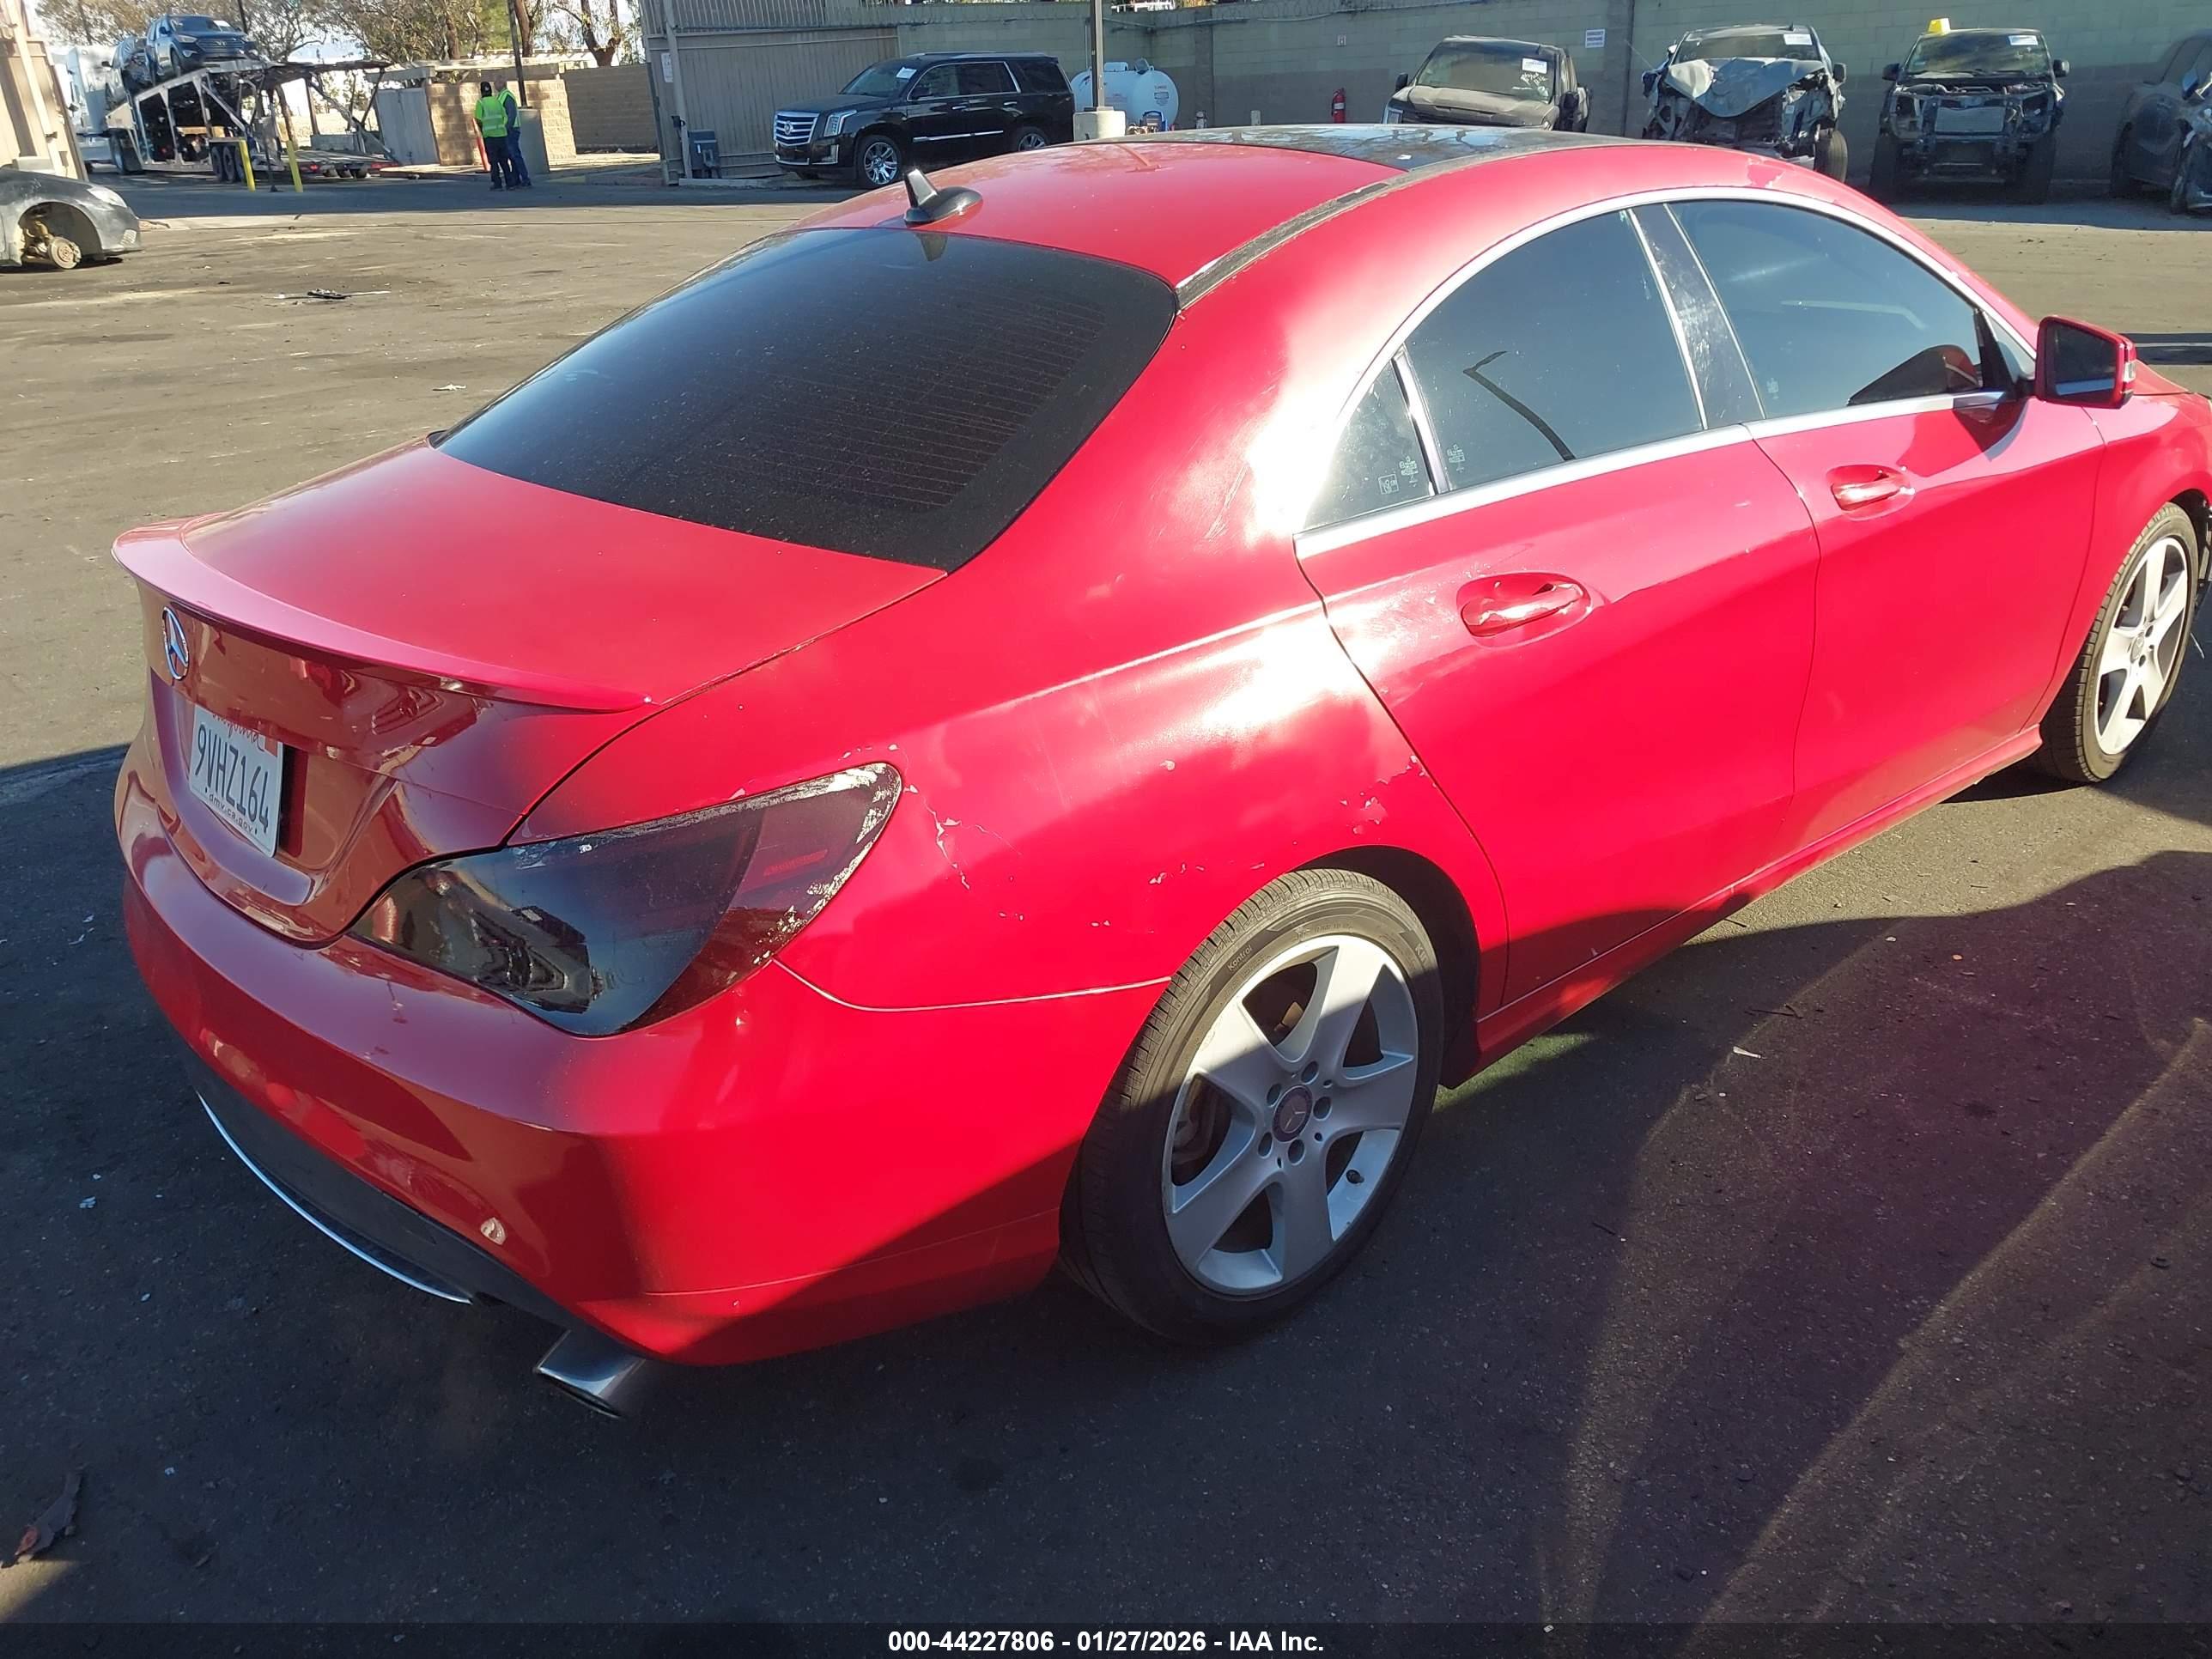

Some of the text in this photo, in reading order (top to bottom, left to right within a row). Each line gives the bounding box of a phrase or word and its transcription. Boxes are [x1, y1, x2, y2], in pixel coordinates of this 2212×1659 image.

[195, 723, 269, 833] 9VHZ164
[209, 793, 253, 832] dmv.ca.gov
[1227, 944, 1253, 971] Kontrol
